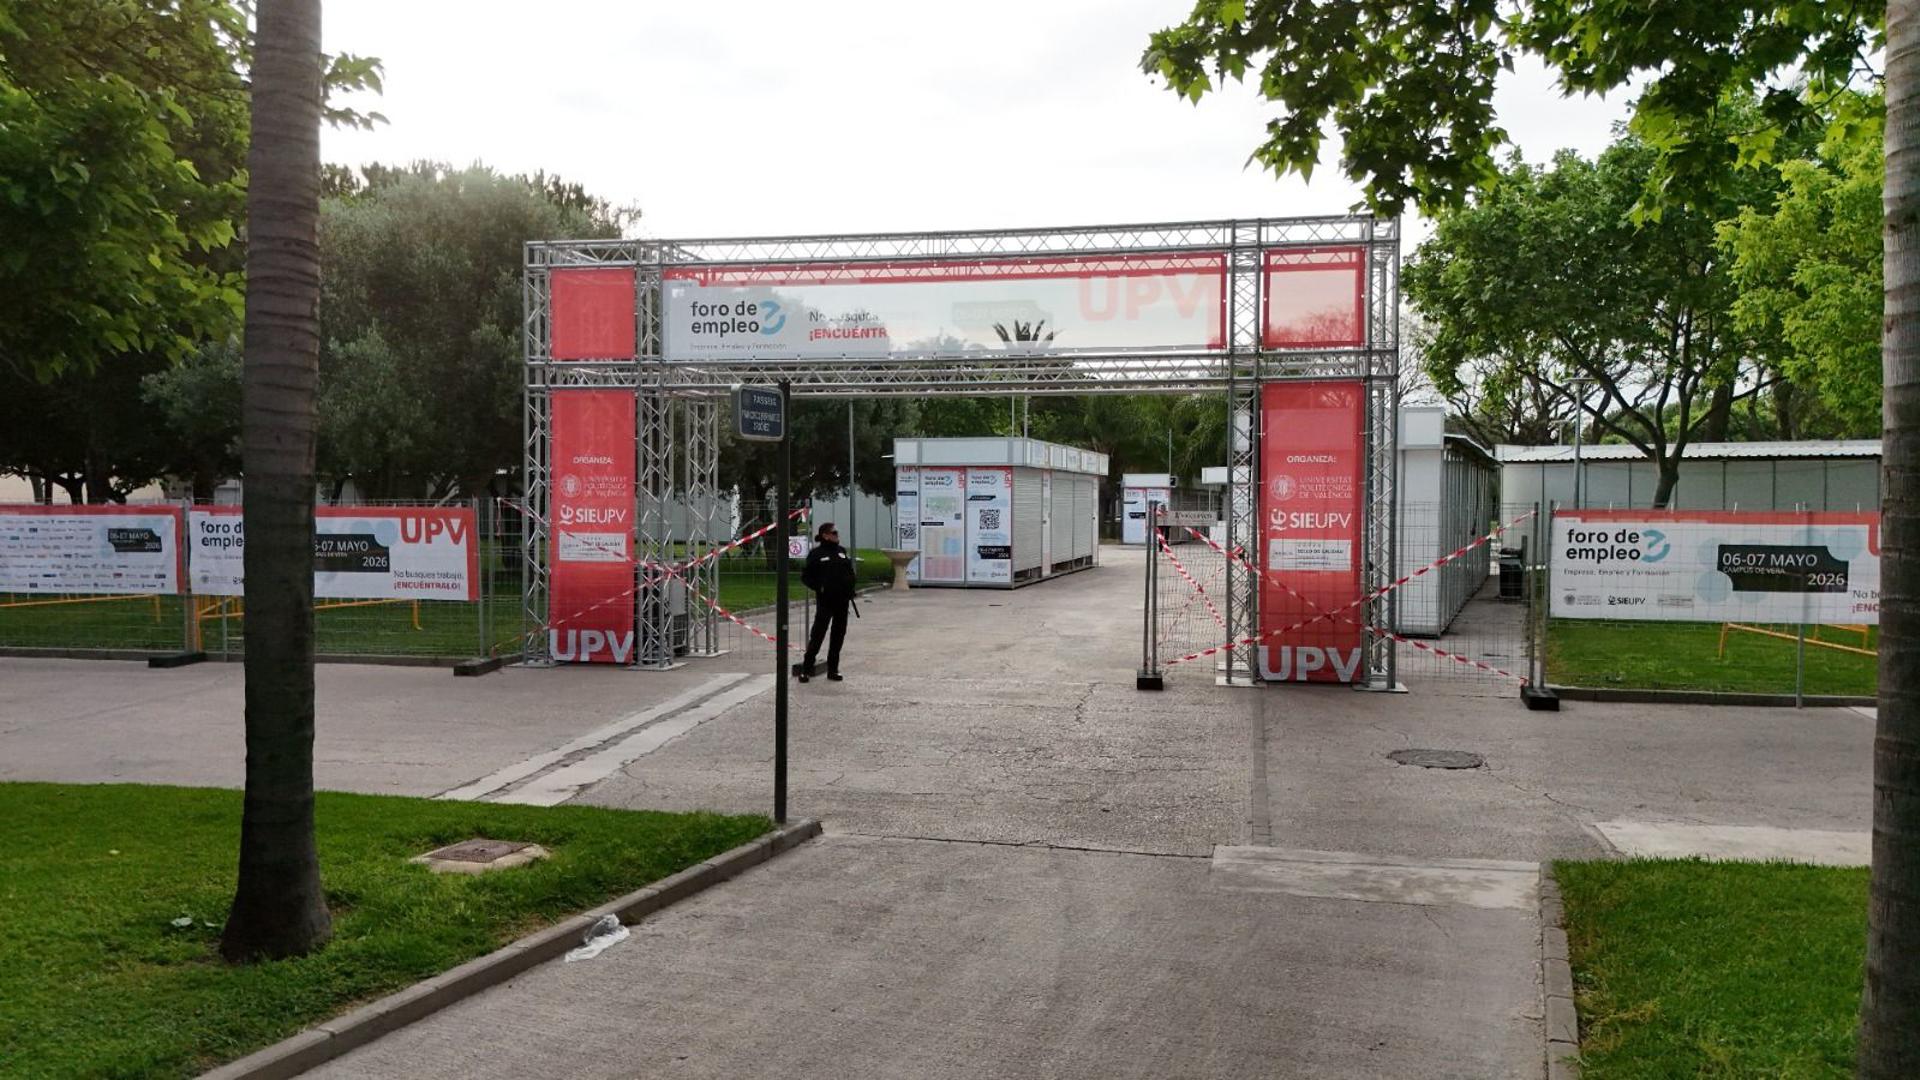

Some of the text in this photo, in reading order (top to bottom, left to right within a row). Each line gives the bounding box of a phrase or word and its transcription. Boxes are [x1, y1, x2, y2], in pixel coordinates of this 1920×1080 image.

[1080, 277, 1205, 321] UPV
[690, 300, 757, 317] foro de
[691, 318, 760, 338] empleo
[809, 325, 887, 341] ¡ENCUÉNTR
[1286, 455, 1336, 463] ORGANIZA:
[575, 508, 627, 524] SIEUPV
[1290, 512, 1352, 529] SIEUPV
[201, 521, 242, 534] foro d
[401, 517, 467, 545] UPV
[201, 535, 244, 551] emple
[1567, 529, 1640, 543] foro de
[336, 541, 369, 552] MAYO
[1566, 545, 1641, 564] empleo
[362, 556, 388, 567] 2026
[1722, 552, 1818, 567] 06-07 MAYO
[393, 569, 404, 578] No
[1723, 566, 1754, 574] CAMPUS
[1755, 567, 1764, 575] DE
[1807, 573, 1845, 586] 2026
[1853, 590, 1868, 599] No
[549, 629, 634, 663] UPV
[1257, 645, 1362, 682] UPV
